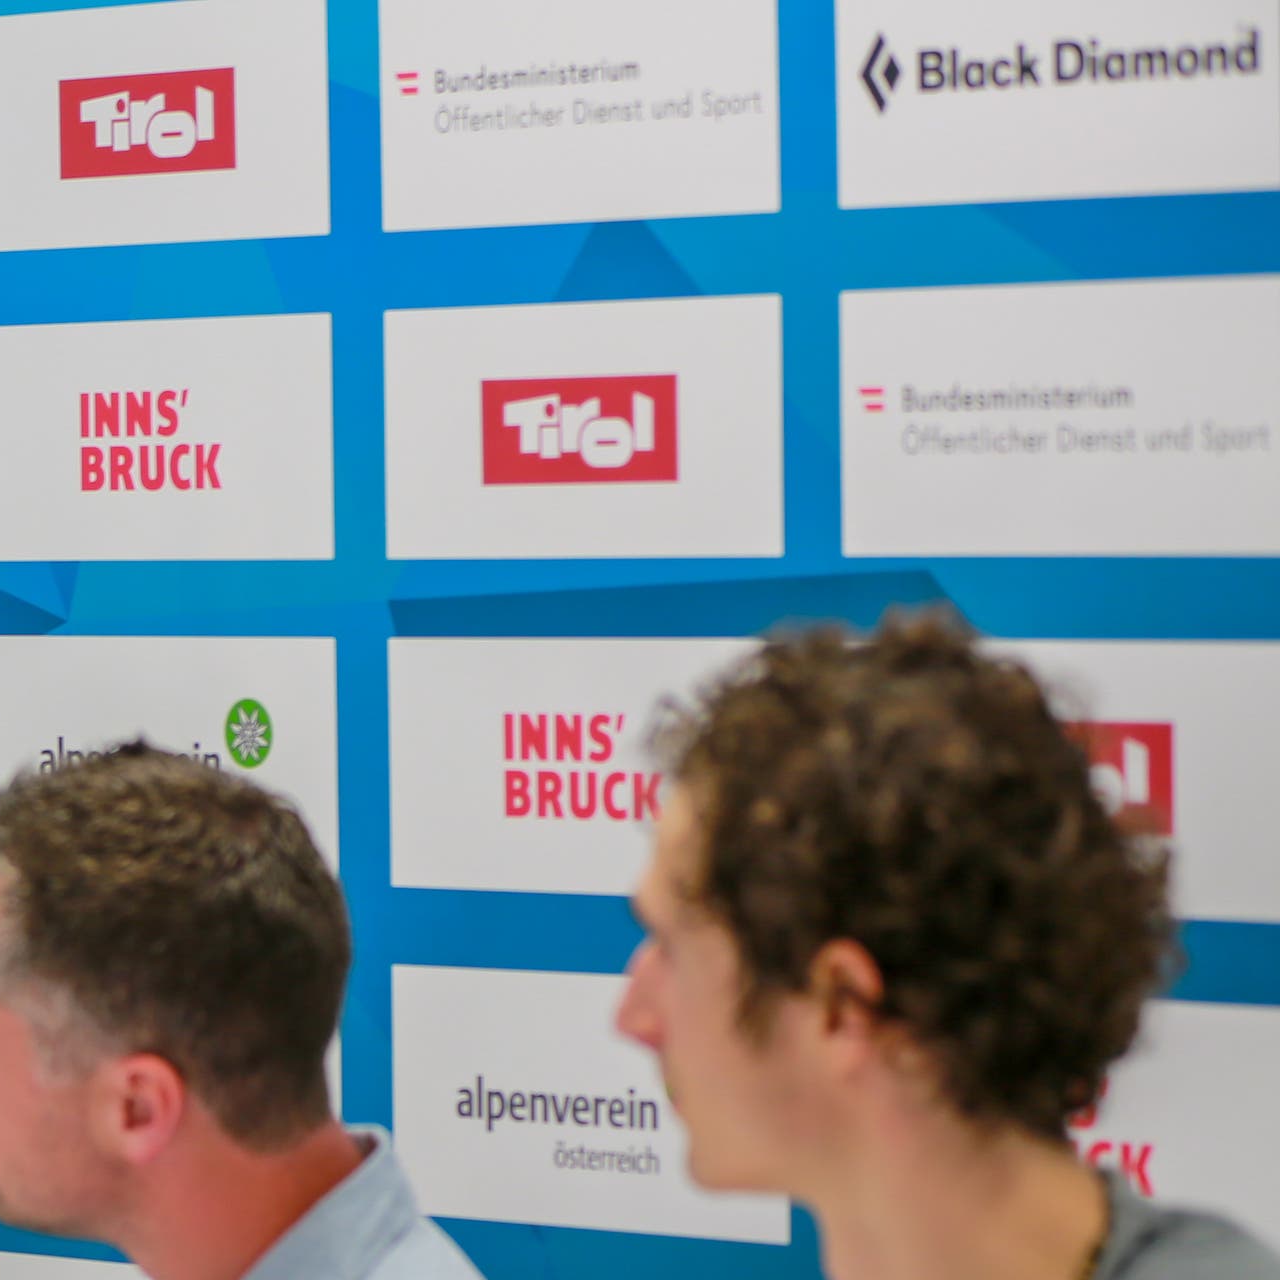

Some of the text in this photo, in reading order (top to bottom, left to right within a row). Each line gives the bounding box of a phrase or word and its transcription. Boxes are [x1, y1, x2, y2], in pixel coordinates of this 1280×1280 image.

[434, 59, 640, 93] Bundesministerium
[917, 28, 1260, 93] Black Diamond
[80, 86, 214, 158] Tirol
[435, 89, 763, 135] Öffentlicher Dienst und Sport
[902, 383, 1133, 413] Bundesministerium
[503, 392, 654, 468] Tirol
[902, 419, 1270, 455] Öffentlicher Dienst und Sport
[80, 444, 221, 491] BRUCK
[504, 770, 662, 820] BRUCK
[457, 1077, 658, 1132] alpenverein
[554, 1142, 659, 1175] österreich
